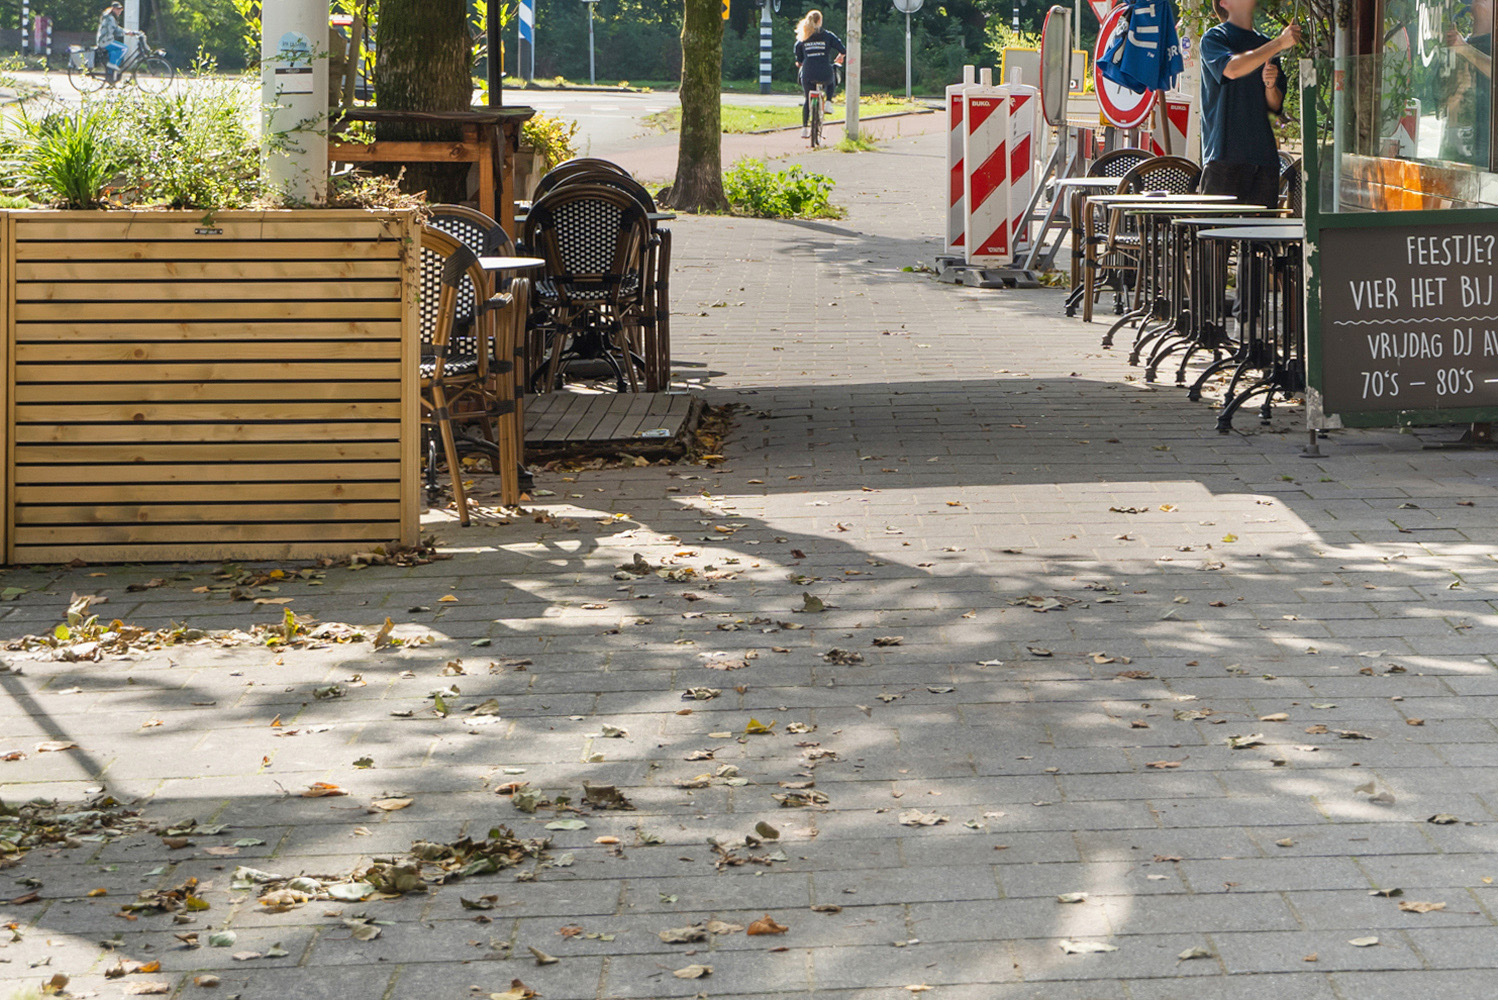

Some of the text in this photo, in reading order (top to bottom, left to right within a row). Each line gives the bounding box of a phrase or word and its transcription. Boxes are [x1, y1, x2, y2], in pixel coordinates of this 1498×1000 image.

[1407, 234, 1496, 266] FEESTJE?
[1349, 277, 1399, 310] VIER
[1411, 277, 1448, 308] HET
[1460, 275, 1493, 308] BIJ
[1367, 332, 1443, 359] VRIJDAG
[1453, 328, 1473, 357] DJ
